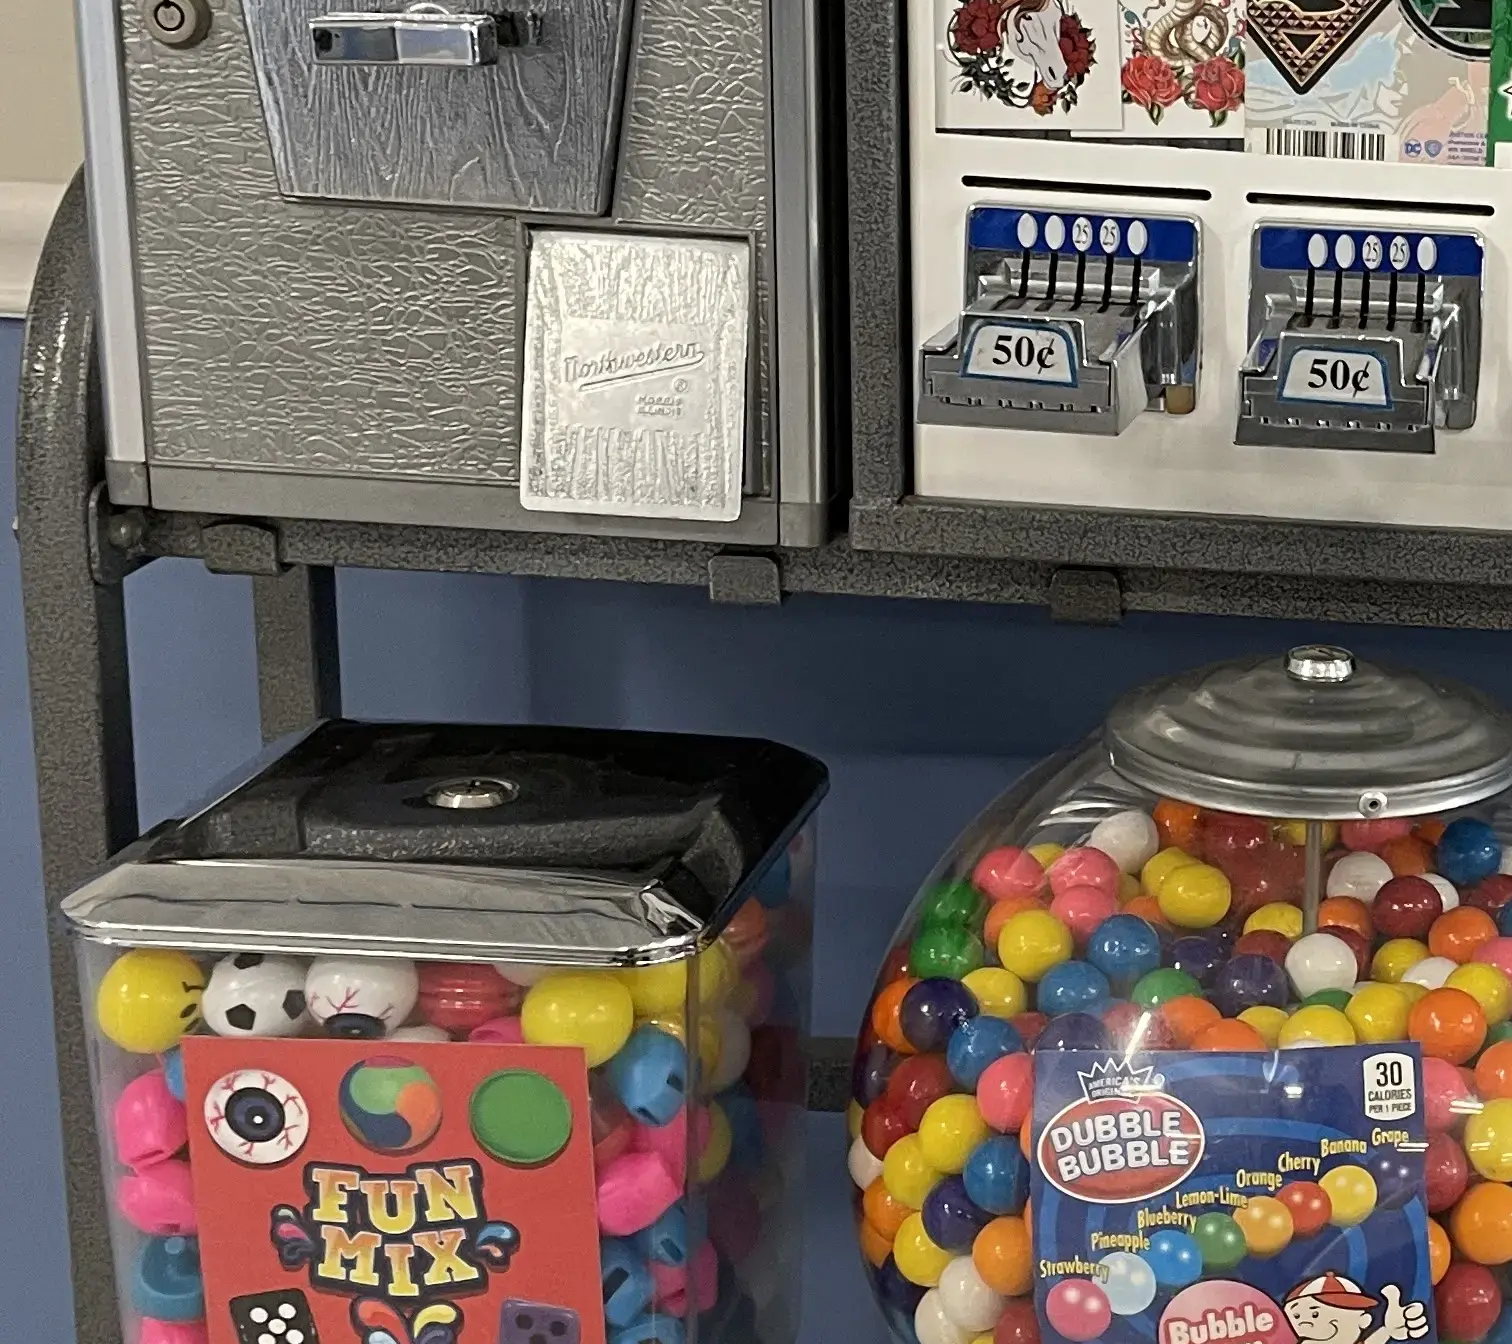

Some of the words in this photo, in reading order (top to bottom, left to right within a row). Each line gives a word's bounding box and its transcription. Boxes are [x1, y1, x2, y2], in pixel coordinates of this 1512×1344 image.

[992, 335, 1055, 375] 50¢
[1307, 359, 1370, 397] 50¢
[1376, 1061, 1403, 1087] 30
[1368, 1089, 1413, 1102] CALORIES
[1369, 1105, 1384, 1113] PER
[1050, 1111, 1184, 1154] DUBBLE
[1371, 1127, 1410, 1149] Grape
[1320, 1138, 1368, 1156] Banana
[1057, 1139, 1190, 1183] BUBBLE
[1277, 1152, 1322, 1176] Cherry
[1235, 1168, 1283, 1190] Orange
[311, 1164, 479, 1234] FUN
[1175, 1186, 1249, 1211] Lemon-Lime
[1136, 1206, 1197, 1234] Blueberry
[1090, 1231, 1151, 1254] Pineapple
[317, 1225, 480, 1298] MIX
[1039, 1255, 1111, 1283] Strawberry
